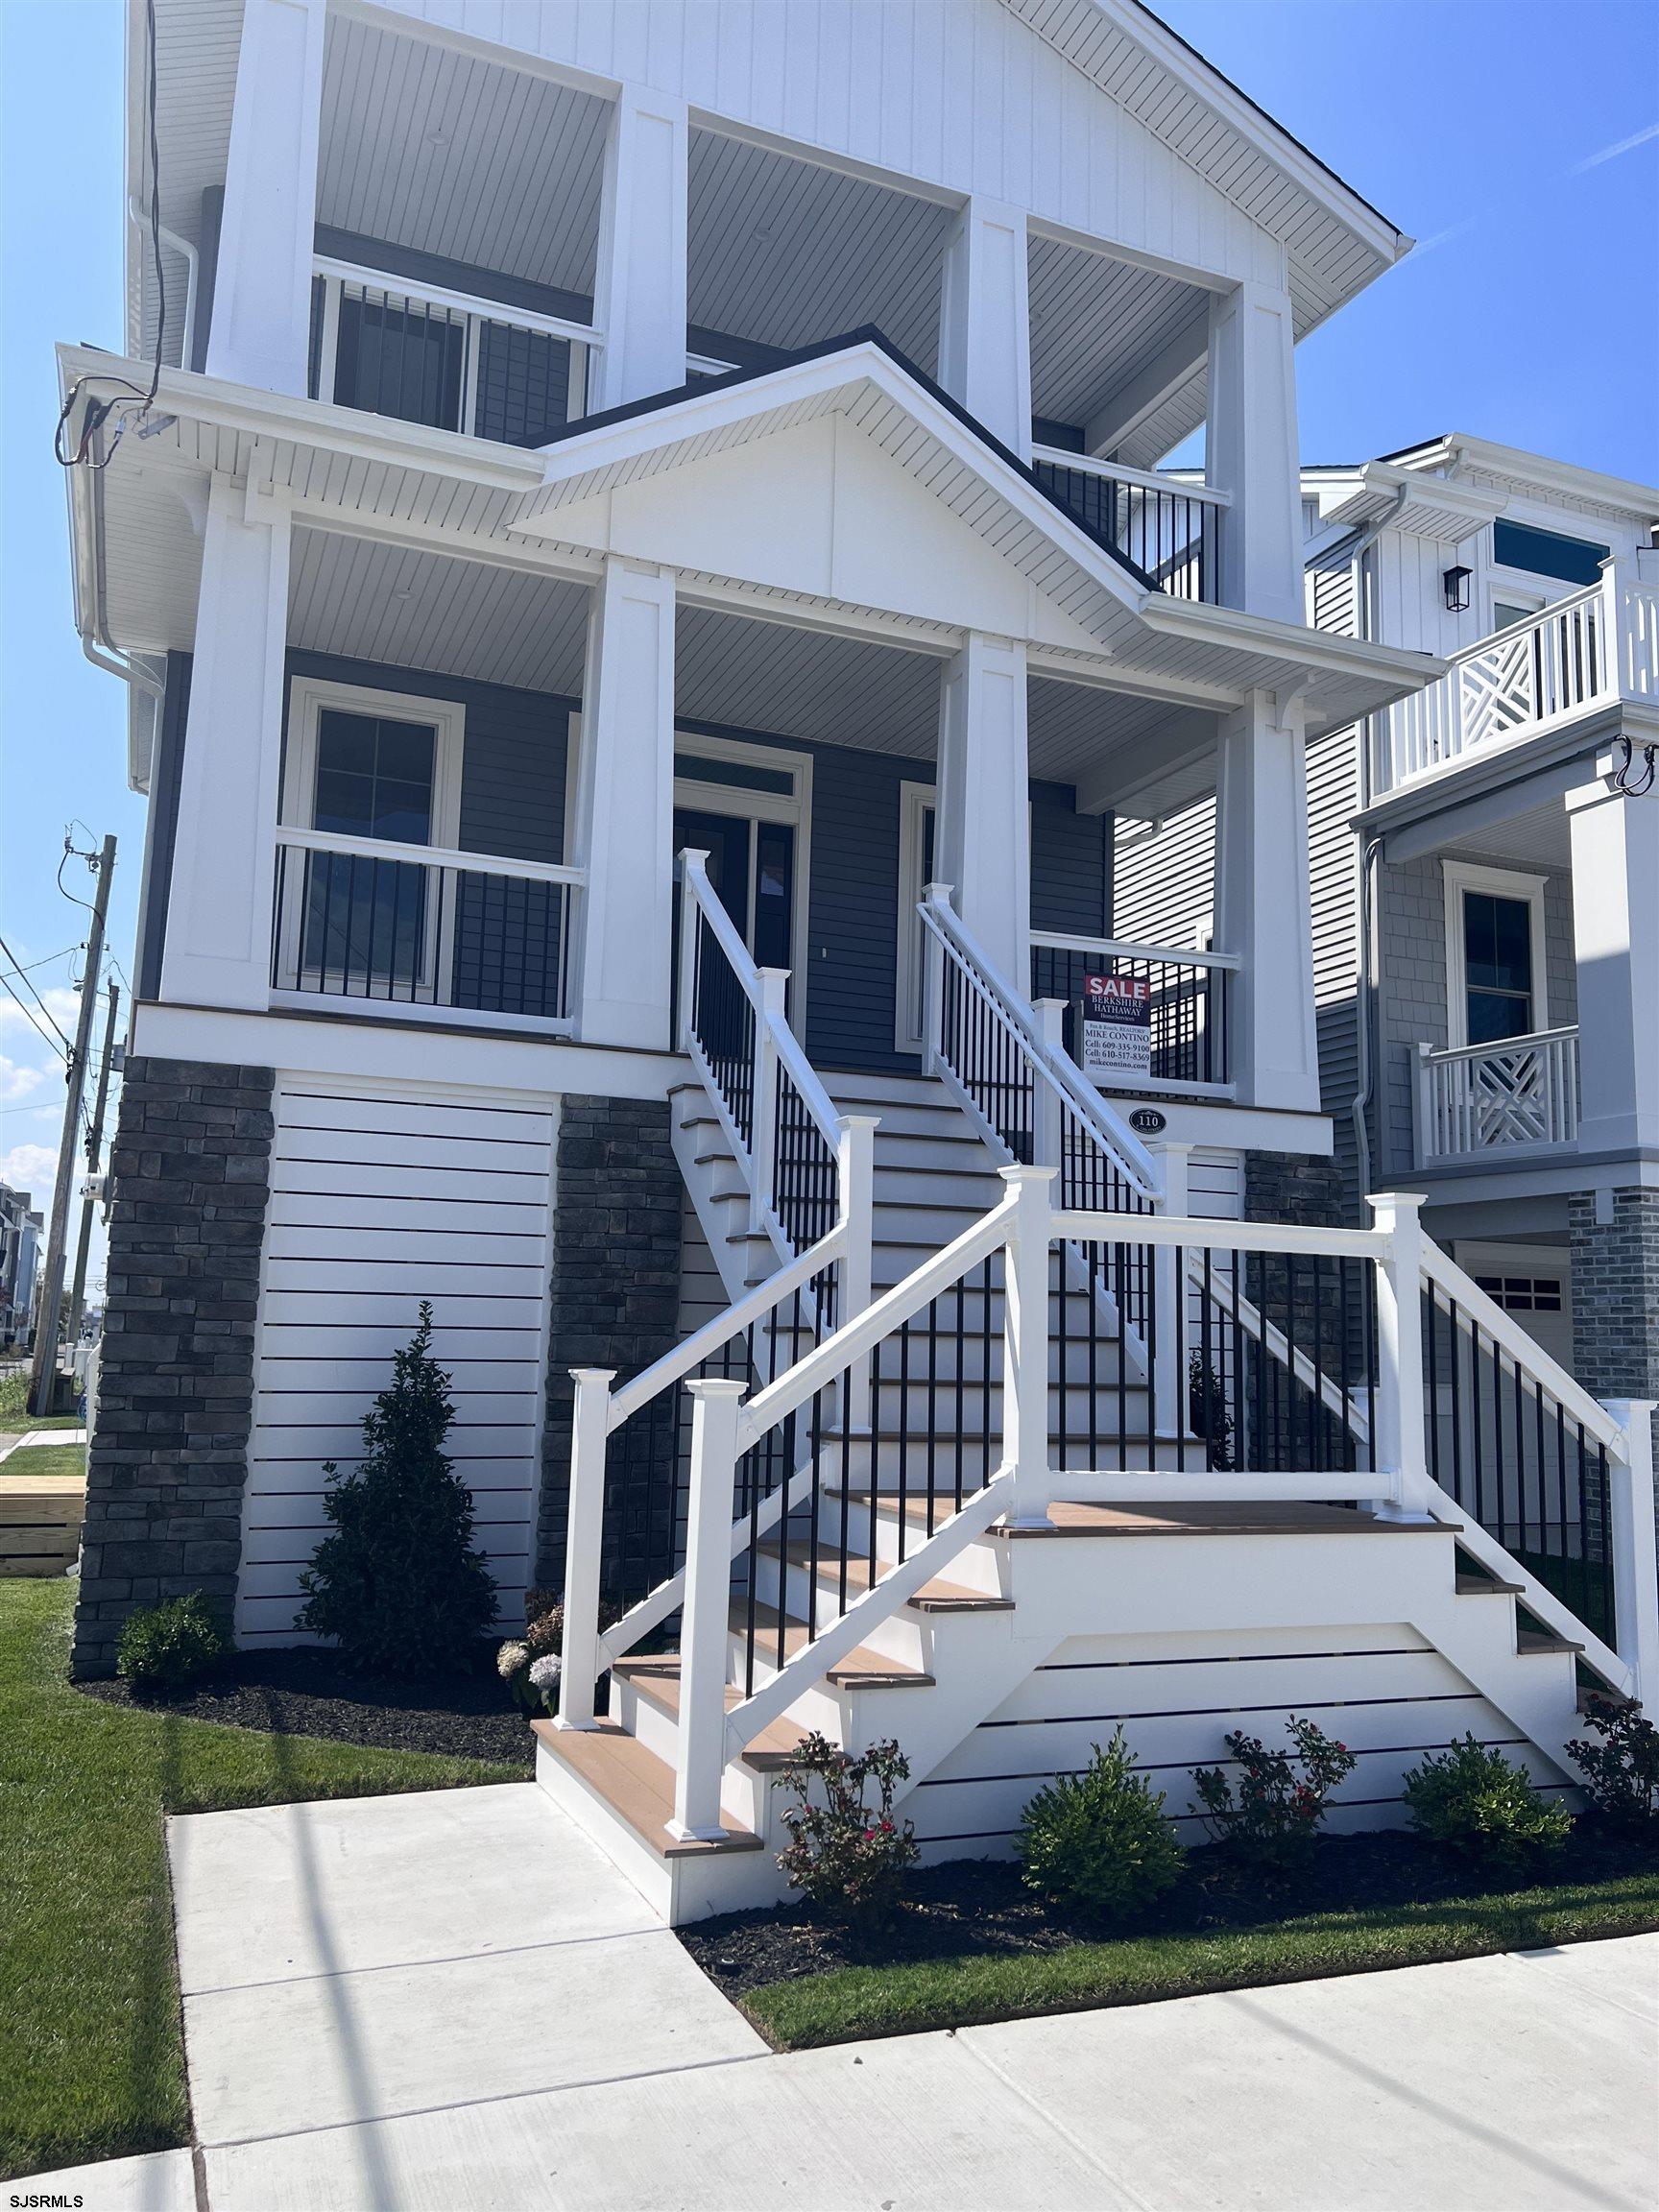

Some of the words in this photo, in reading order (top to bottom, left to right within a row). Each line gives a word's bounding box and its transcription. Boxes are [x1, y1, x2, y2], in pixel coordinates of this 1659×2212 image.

[1090, 977, 1145, 999] SALE
[1092, 996, 1143, 1008] BERKSHIRE
[1094, 1003, 1142, 1017] HATHAWAY
[1085, 1028, 1107, 1039] MIKE
[1109, 1031, 1149, 1043] CONTINO
[1085, 1039, 1101, 1048] Cell:
[1102, 1041, 1150, 1052] 609-335-9100
[1085, 1048, 1101, 1057] Cell:
[1101, 1050, 1150, 1062] 610-517-8369
[1089, 1057, 1147, 1070] mikecontino.com
[1139, 1116, 1159, 1127] 110
